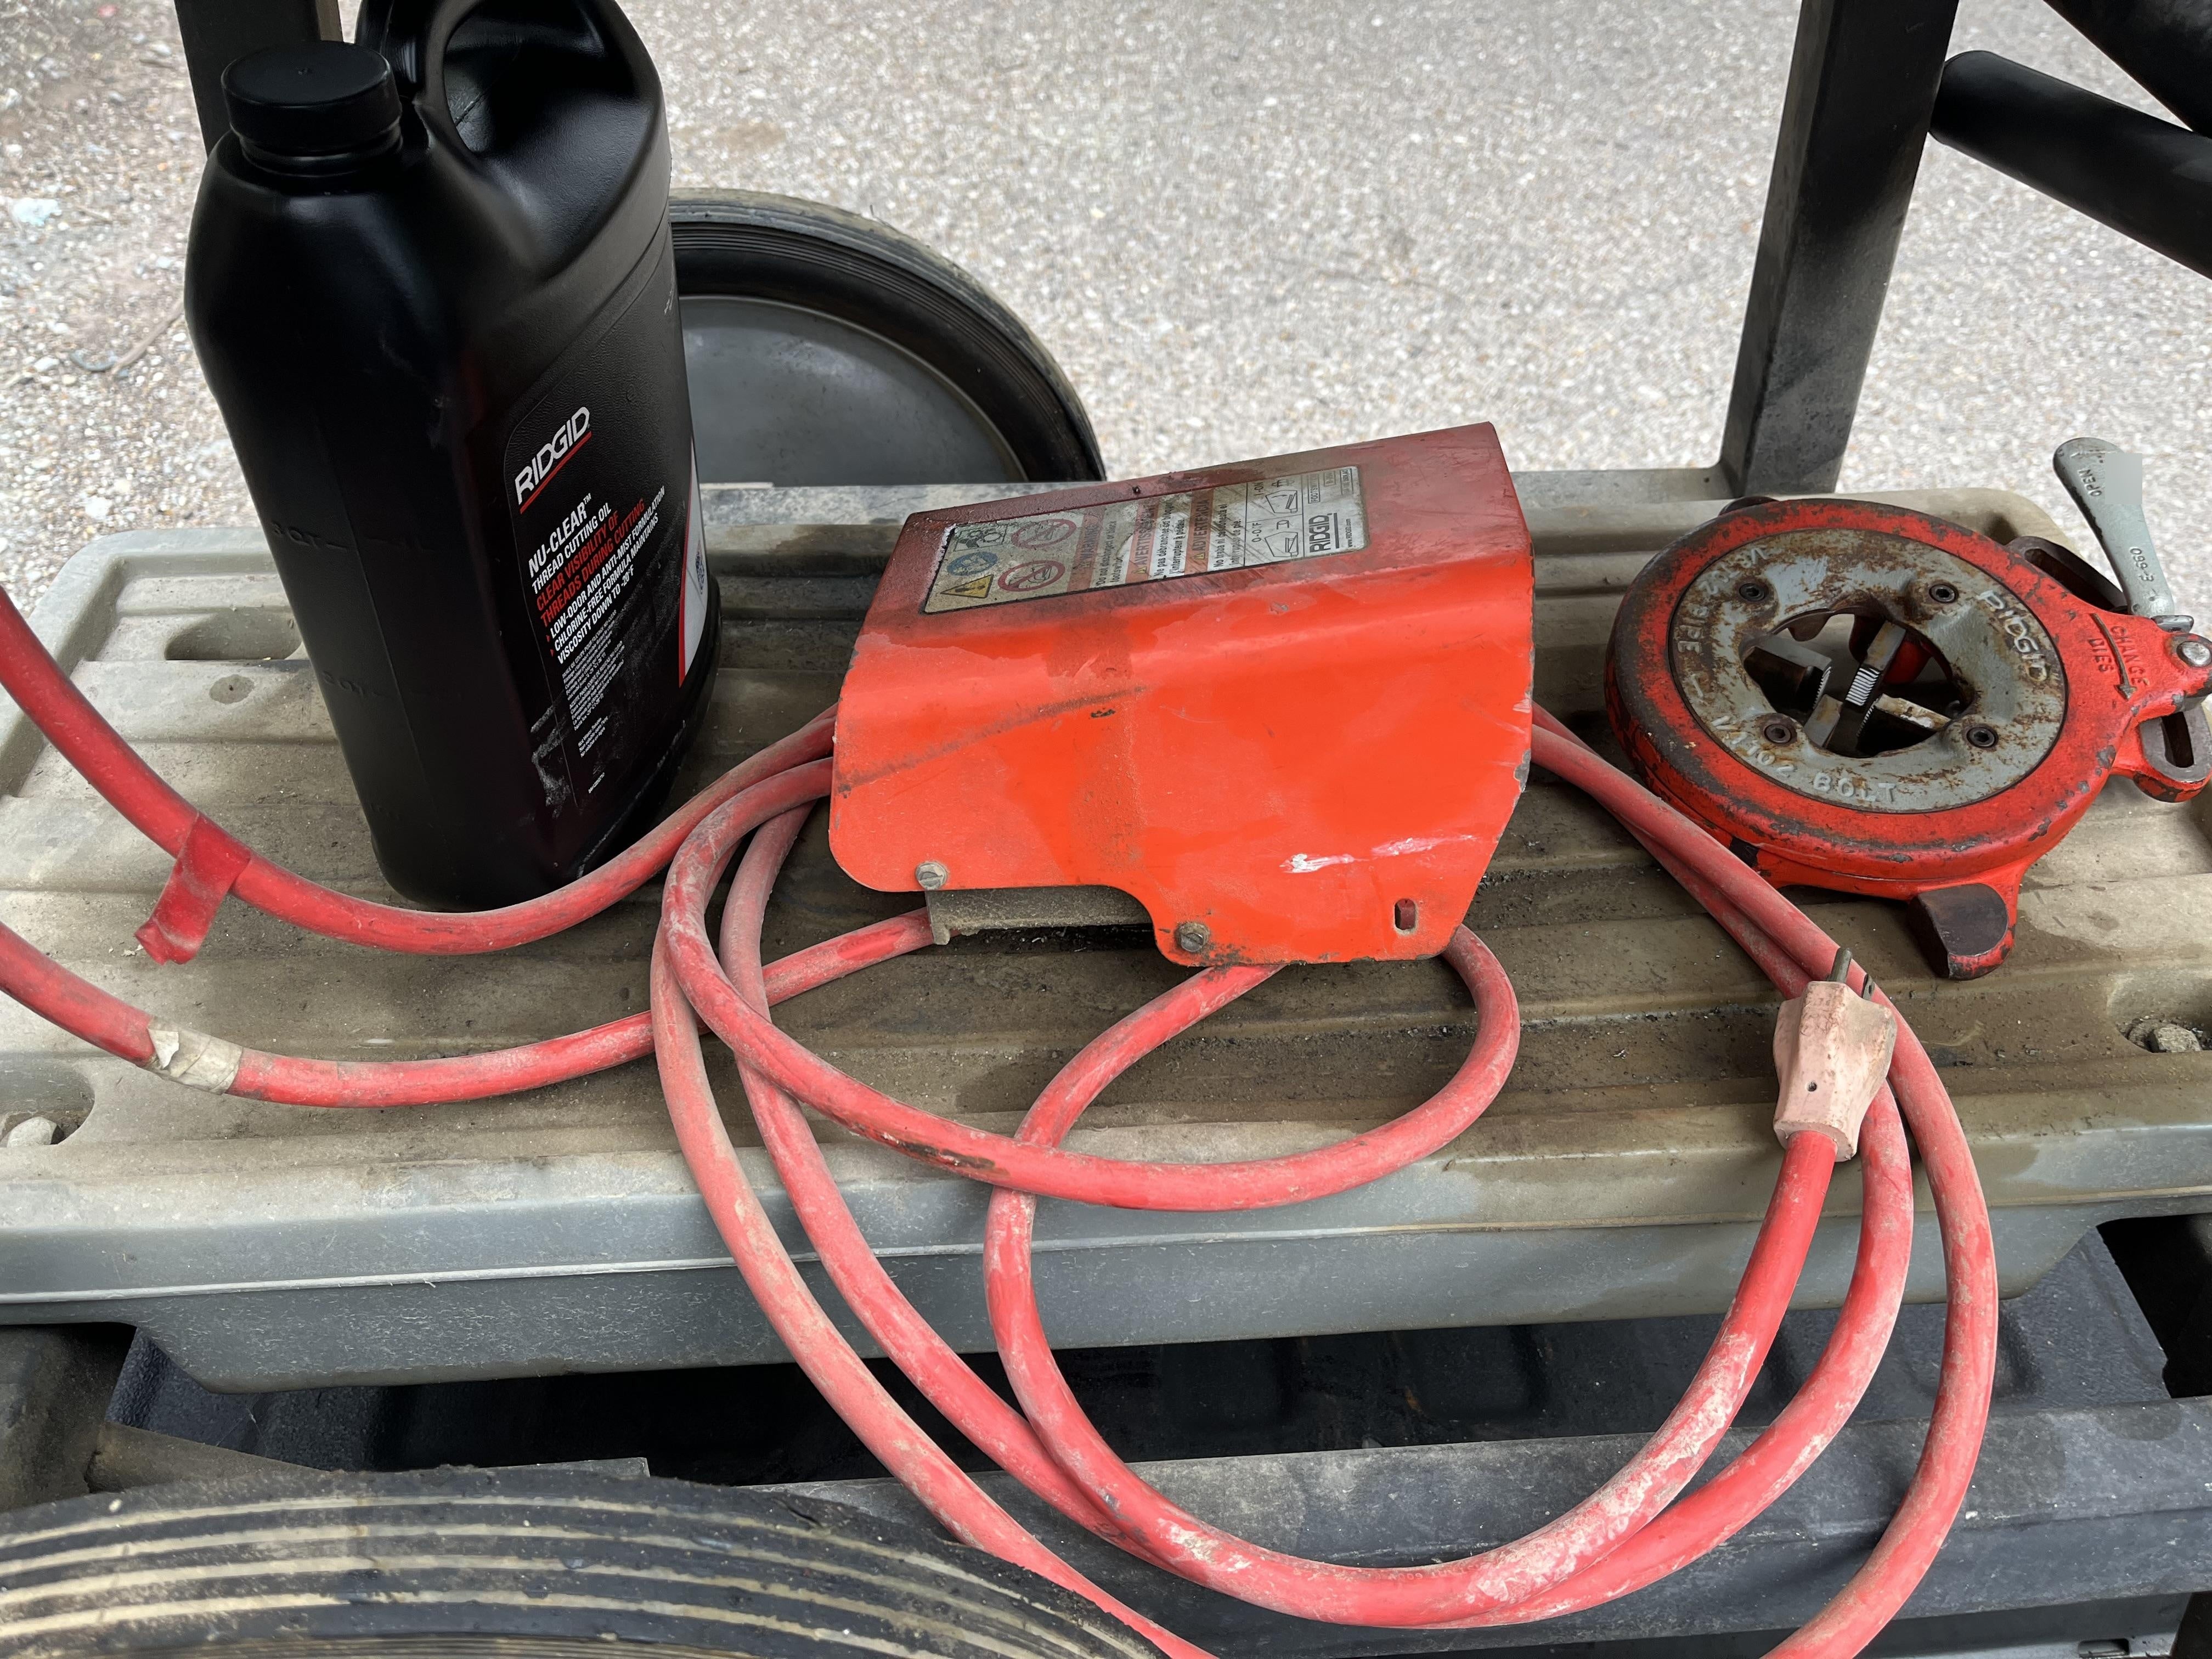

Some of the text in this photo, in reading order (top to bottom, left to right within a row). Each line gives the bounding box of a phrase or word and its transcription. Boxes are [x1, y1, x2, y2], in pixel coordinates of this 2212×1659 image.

[515, 407, 590, 505] RIDGID
[2078, 469, 2102, 497] OPEN
[532, 503, 611, 594] THREAD CUTTING OIL
[537, 510, 618, 611] CLEAR VISIBILITY OF
[1191, 499, 1210, 551] ADVERTENCIA
[1251, 522, 1261, 542] 0-OF
[1308, 514, 1331, 552] RIDGID
[540, 498, 644, 627] THREADS DURING CUTTING
[550, 590, 587, 639] LOW-ODOR
[587, 573, 601, 597] AND
[602, 534, 631, 579] ANTI-MIST
[632, 486, 665, 540] FORMULATION
[554, 588, 603, 651] CHLORINE-FREE
[603, 554, 631, 594] FORMULA
[630, 512, 658, 559] MAINTAINS
[1157, 557, 1168, 567] pas
[557, 618, 591, 664] VISCOSITY
[591, 594, 612, 624] DOWN
[611, 583, 620, 599] TO
[1976, 590, 2048, 681] RIDGID
[2089, 638, 2114, 673] DIES
[2112, 625, 2150, 686] CHANGE
[1813, 772, 1897, 803] BOLT
